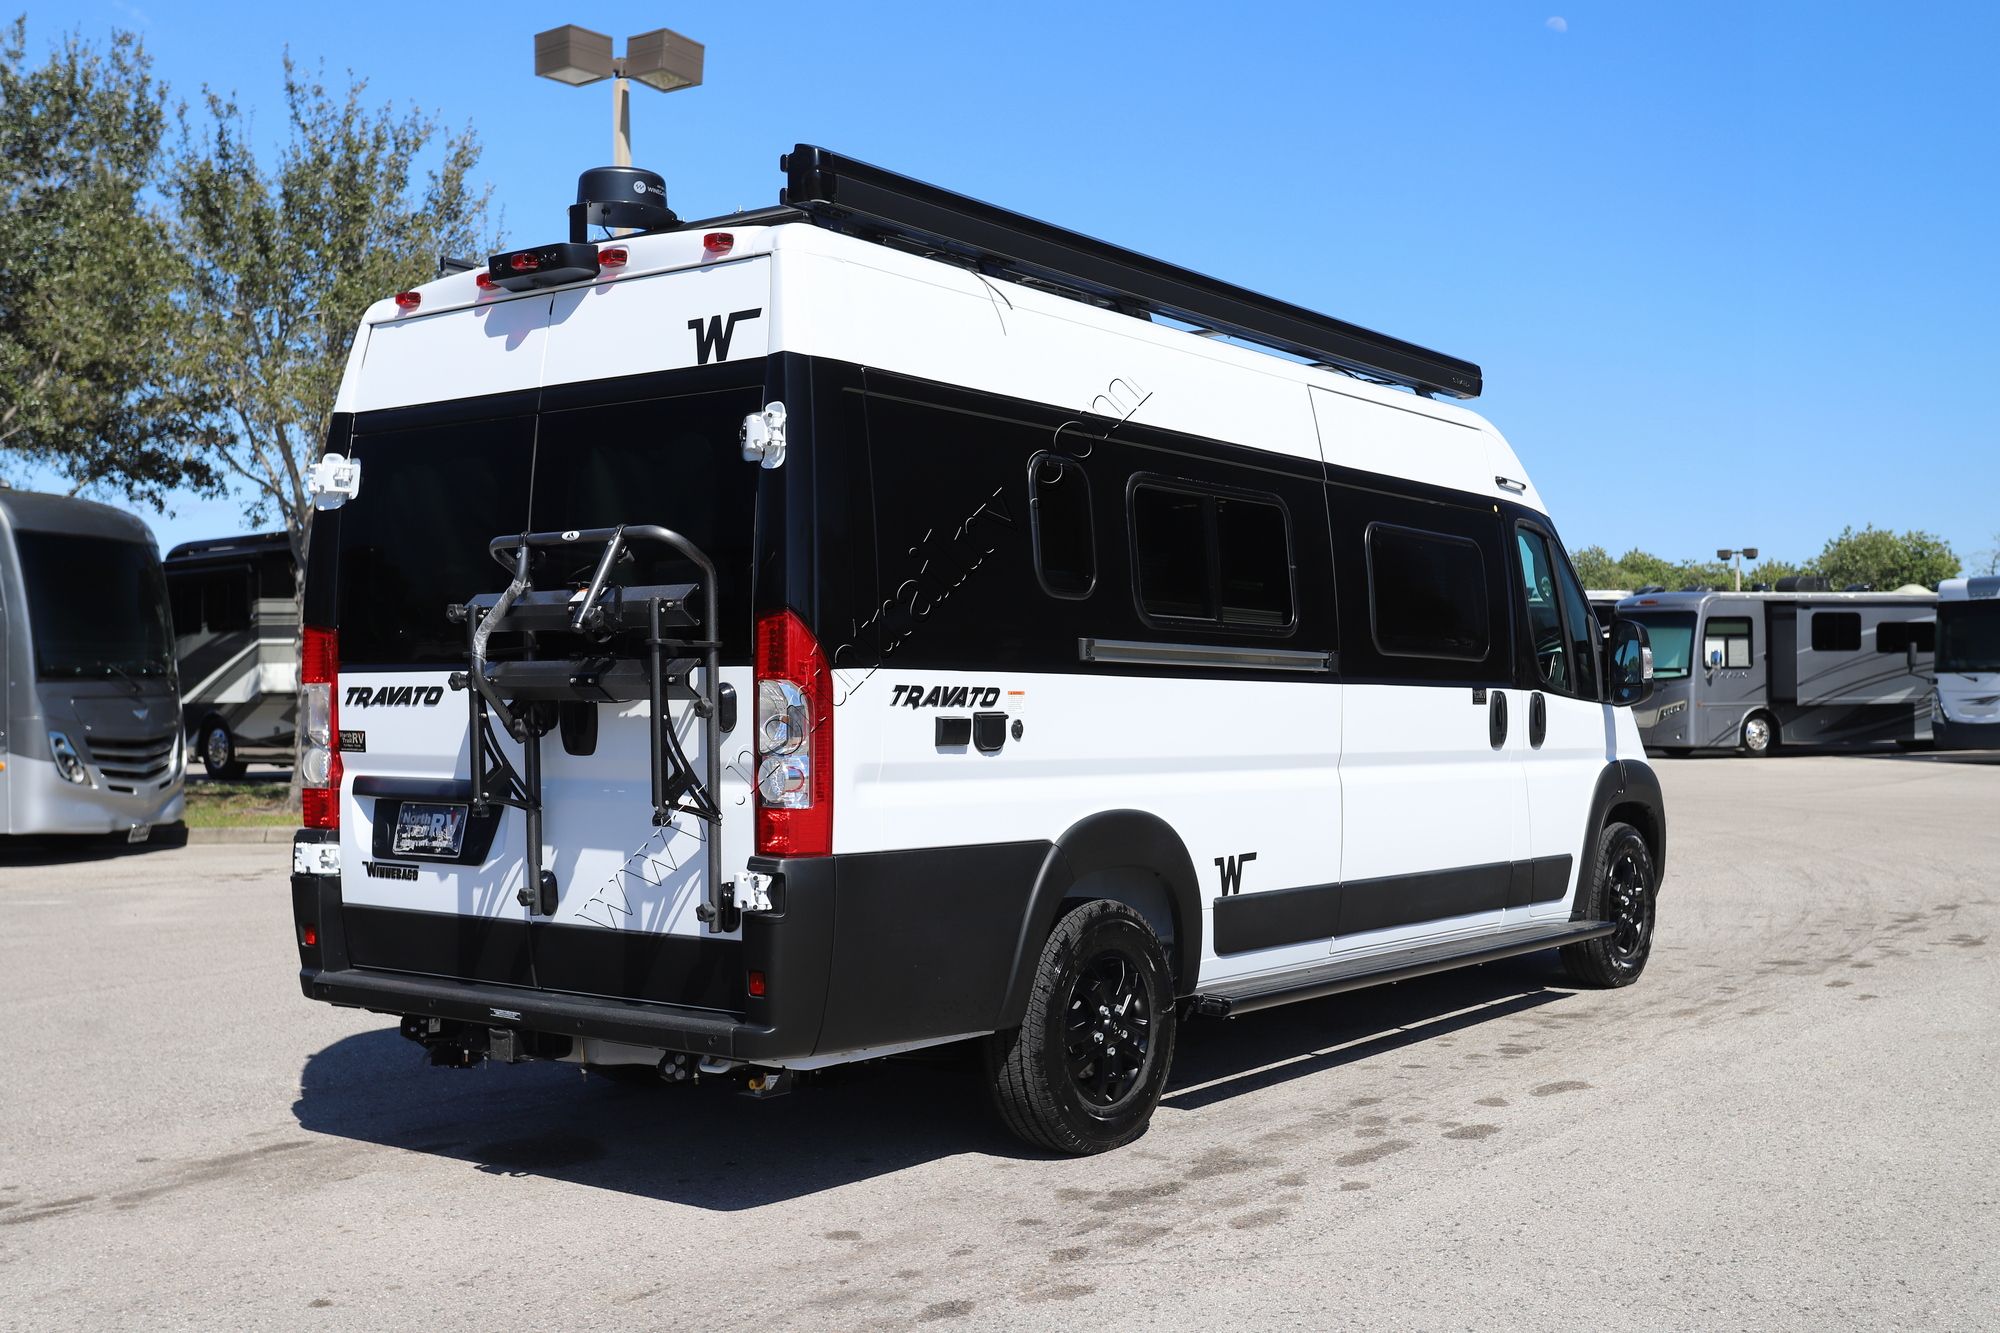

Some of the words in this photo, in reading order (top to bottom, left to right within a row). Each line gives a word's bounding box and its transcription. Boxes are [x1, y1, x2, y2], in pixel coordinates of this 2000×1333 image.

[687, 307, 763, 365] W
[345, 686, 444, 709] TRAVATO
[890, 684, 1001, 710] TRAVATO
[403, 811, 430, 825] North
[429, 813, 461, 839] RV
